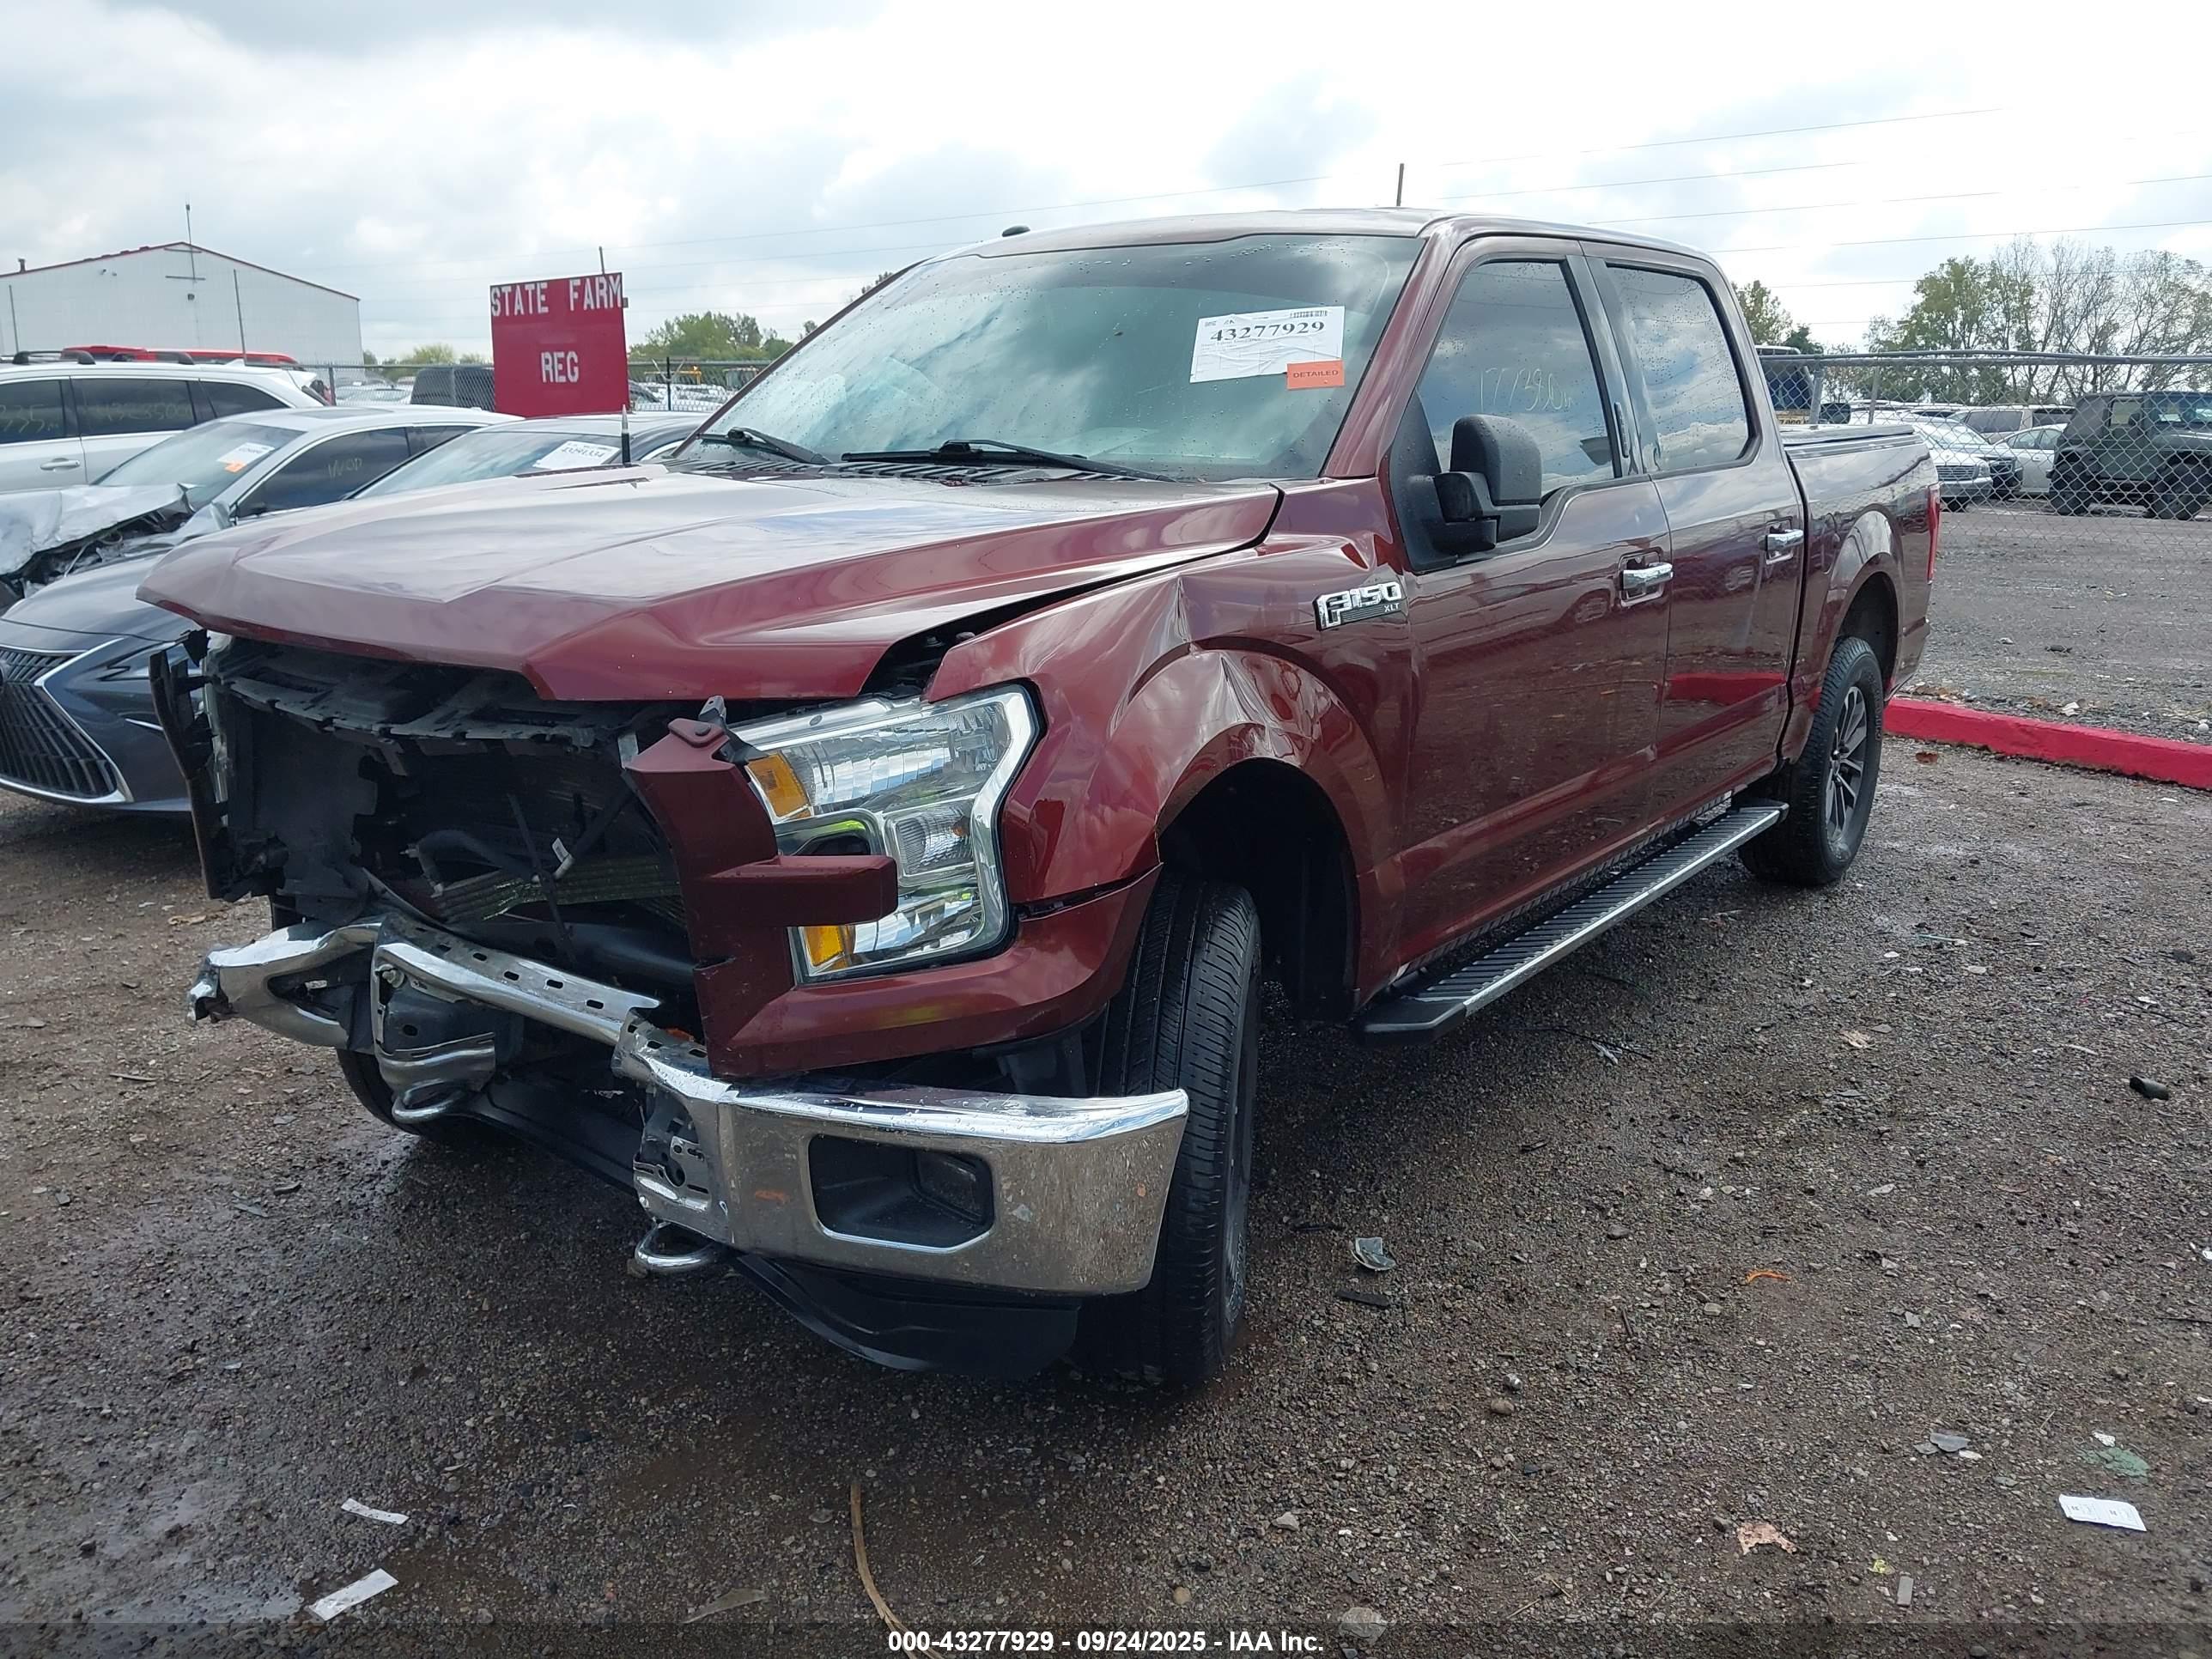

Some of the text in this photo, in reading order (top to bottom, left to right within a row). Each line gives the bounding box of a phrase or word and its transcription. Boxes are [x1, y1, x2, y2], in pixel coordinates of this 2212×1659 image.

[490, 275, 622, 317] STATE FARM
[1211, 321, 1325, 341] 43277929
[541, 350, 579, 383] REG
[1293, 370, 1339, 379] DETAILED
[1383, 602, 1400, 612] XLT
